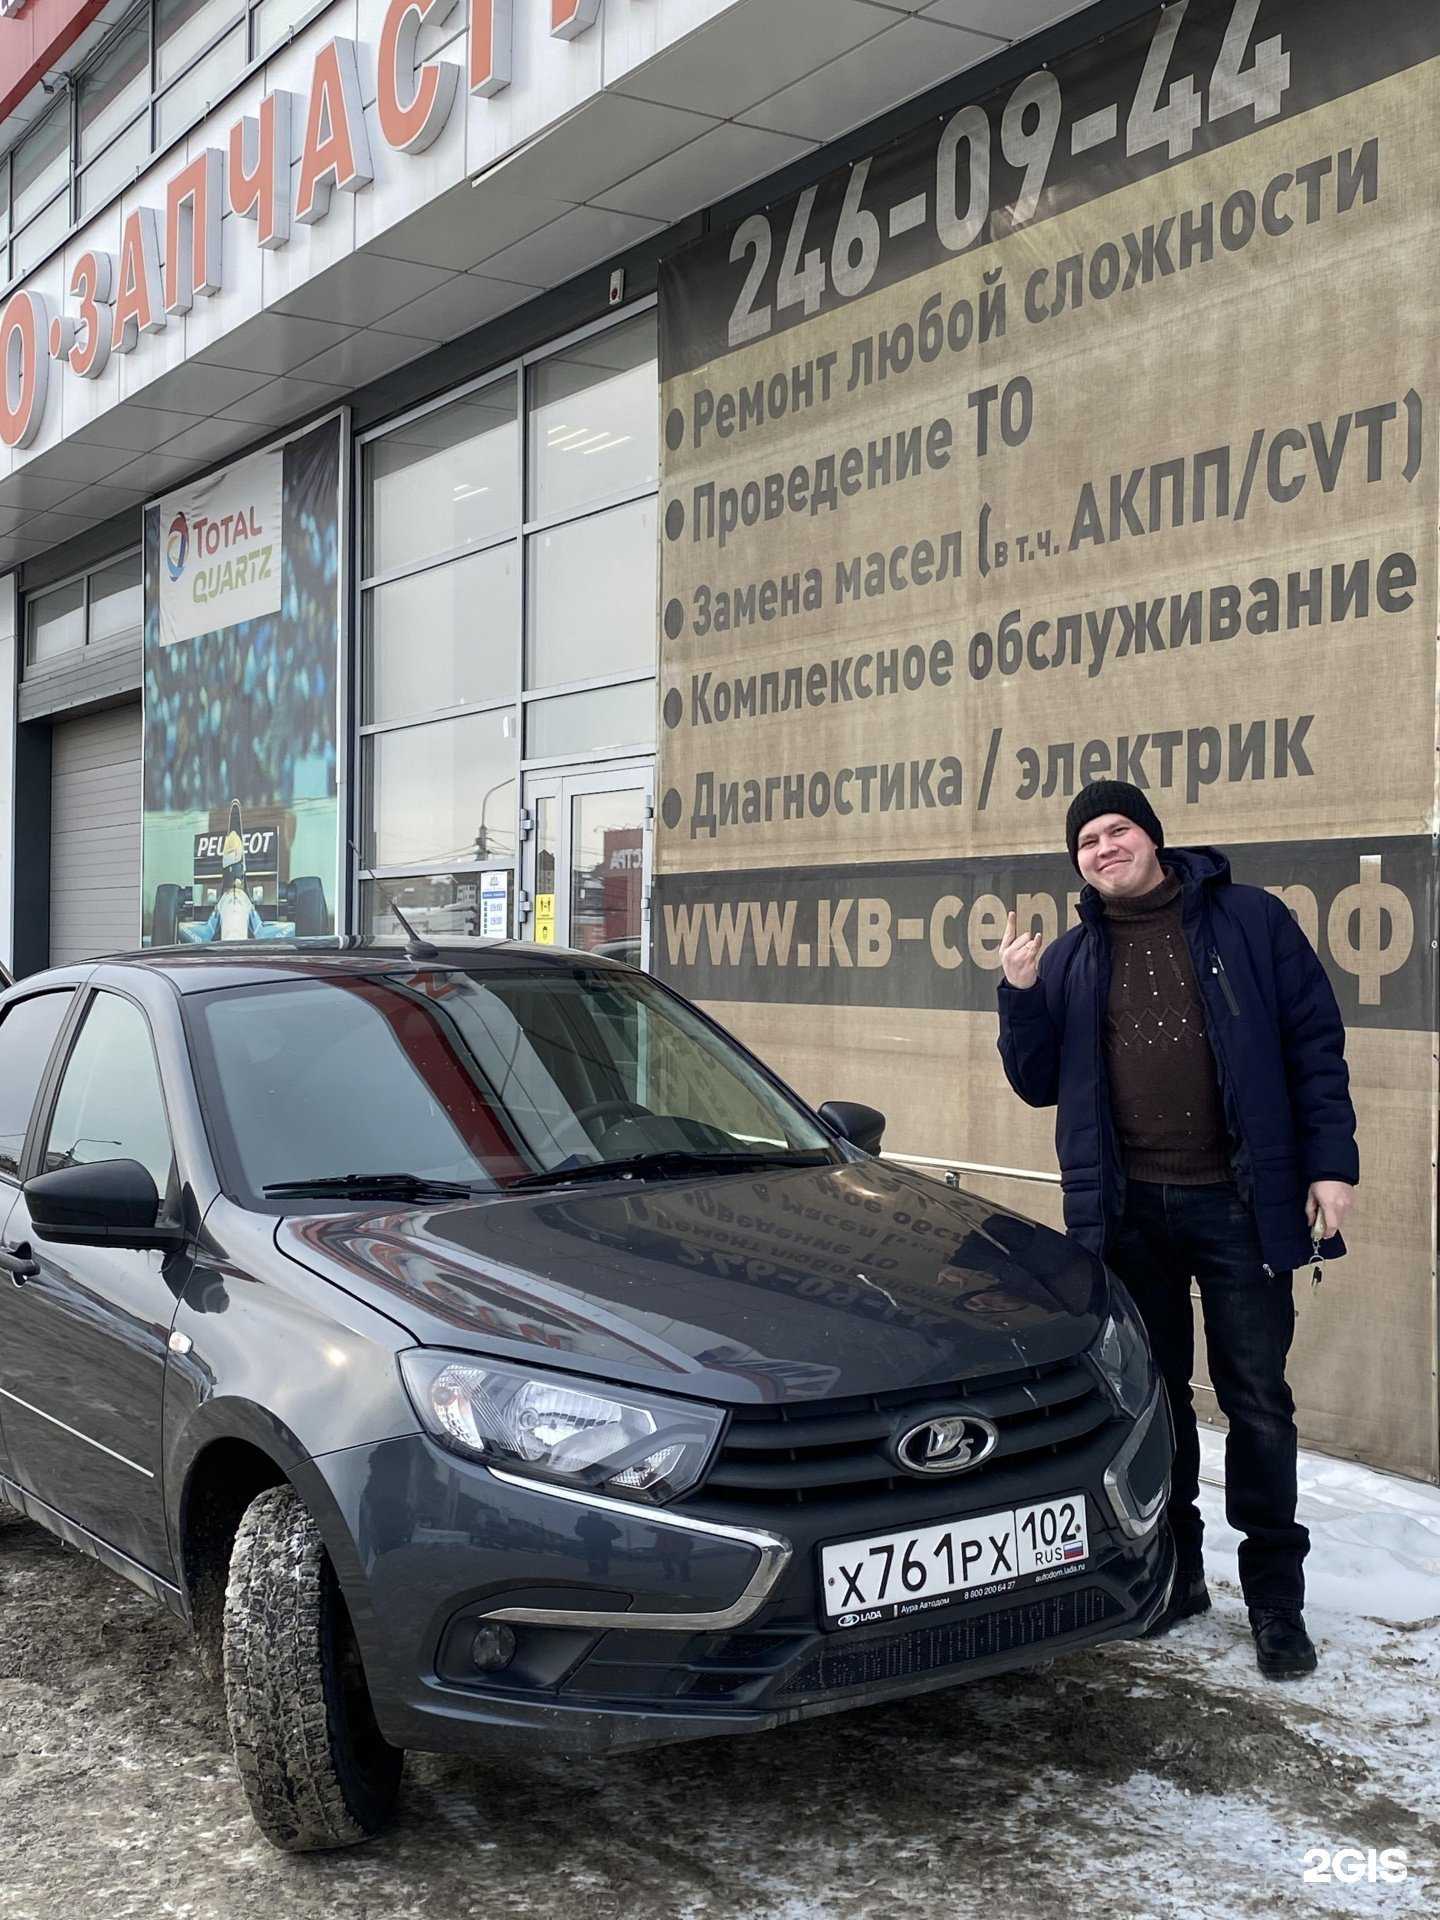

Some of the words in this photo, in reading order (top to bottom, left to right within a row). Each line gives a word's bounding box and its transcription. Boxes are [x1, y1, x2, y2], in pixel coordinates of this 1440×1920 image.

[728, 0, 1291, 347] 246-09-44
[693, 349, 837, 449] Ремонт
[848, 272, 1006, 389] любой
[1025, 138, 1379, 324] сложности
[692, 417, 952, 545] Проведение
[968, 376, 1034, 457] ТО
[193, 506, 263, 558] TOTAL
[193, 545, 273, 604] QUARTZ
[692, 567, 823, 636] Замена
[834, 527, 963, 604] масел
[690, 639, 954, 727] Комплексное
[968, 552, 1418, 681] обслуживание
[690, 755, 963, 839] Диагностика
[1016, 714, 1315, 805] электрик
[197, 831, 274, 857] PEUEOT
[1021, 1503, 1077, 1550] 102
[1035, 1547, 1063, 1566] RUS
[860, 1610, 882, 1622] LADA
[1035, 1563, 1086, 1583] autodom.lada.ru
